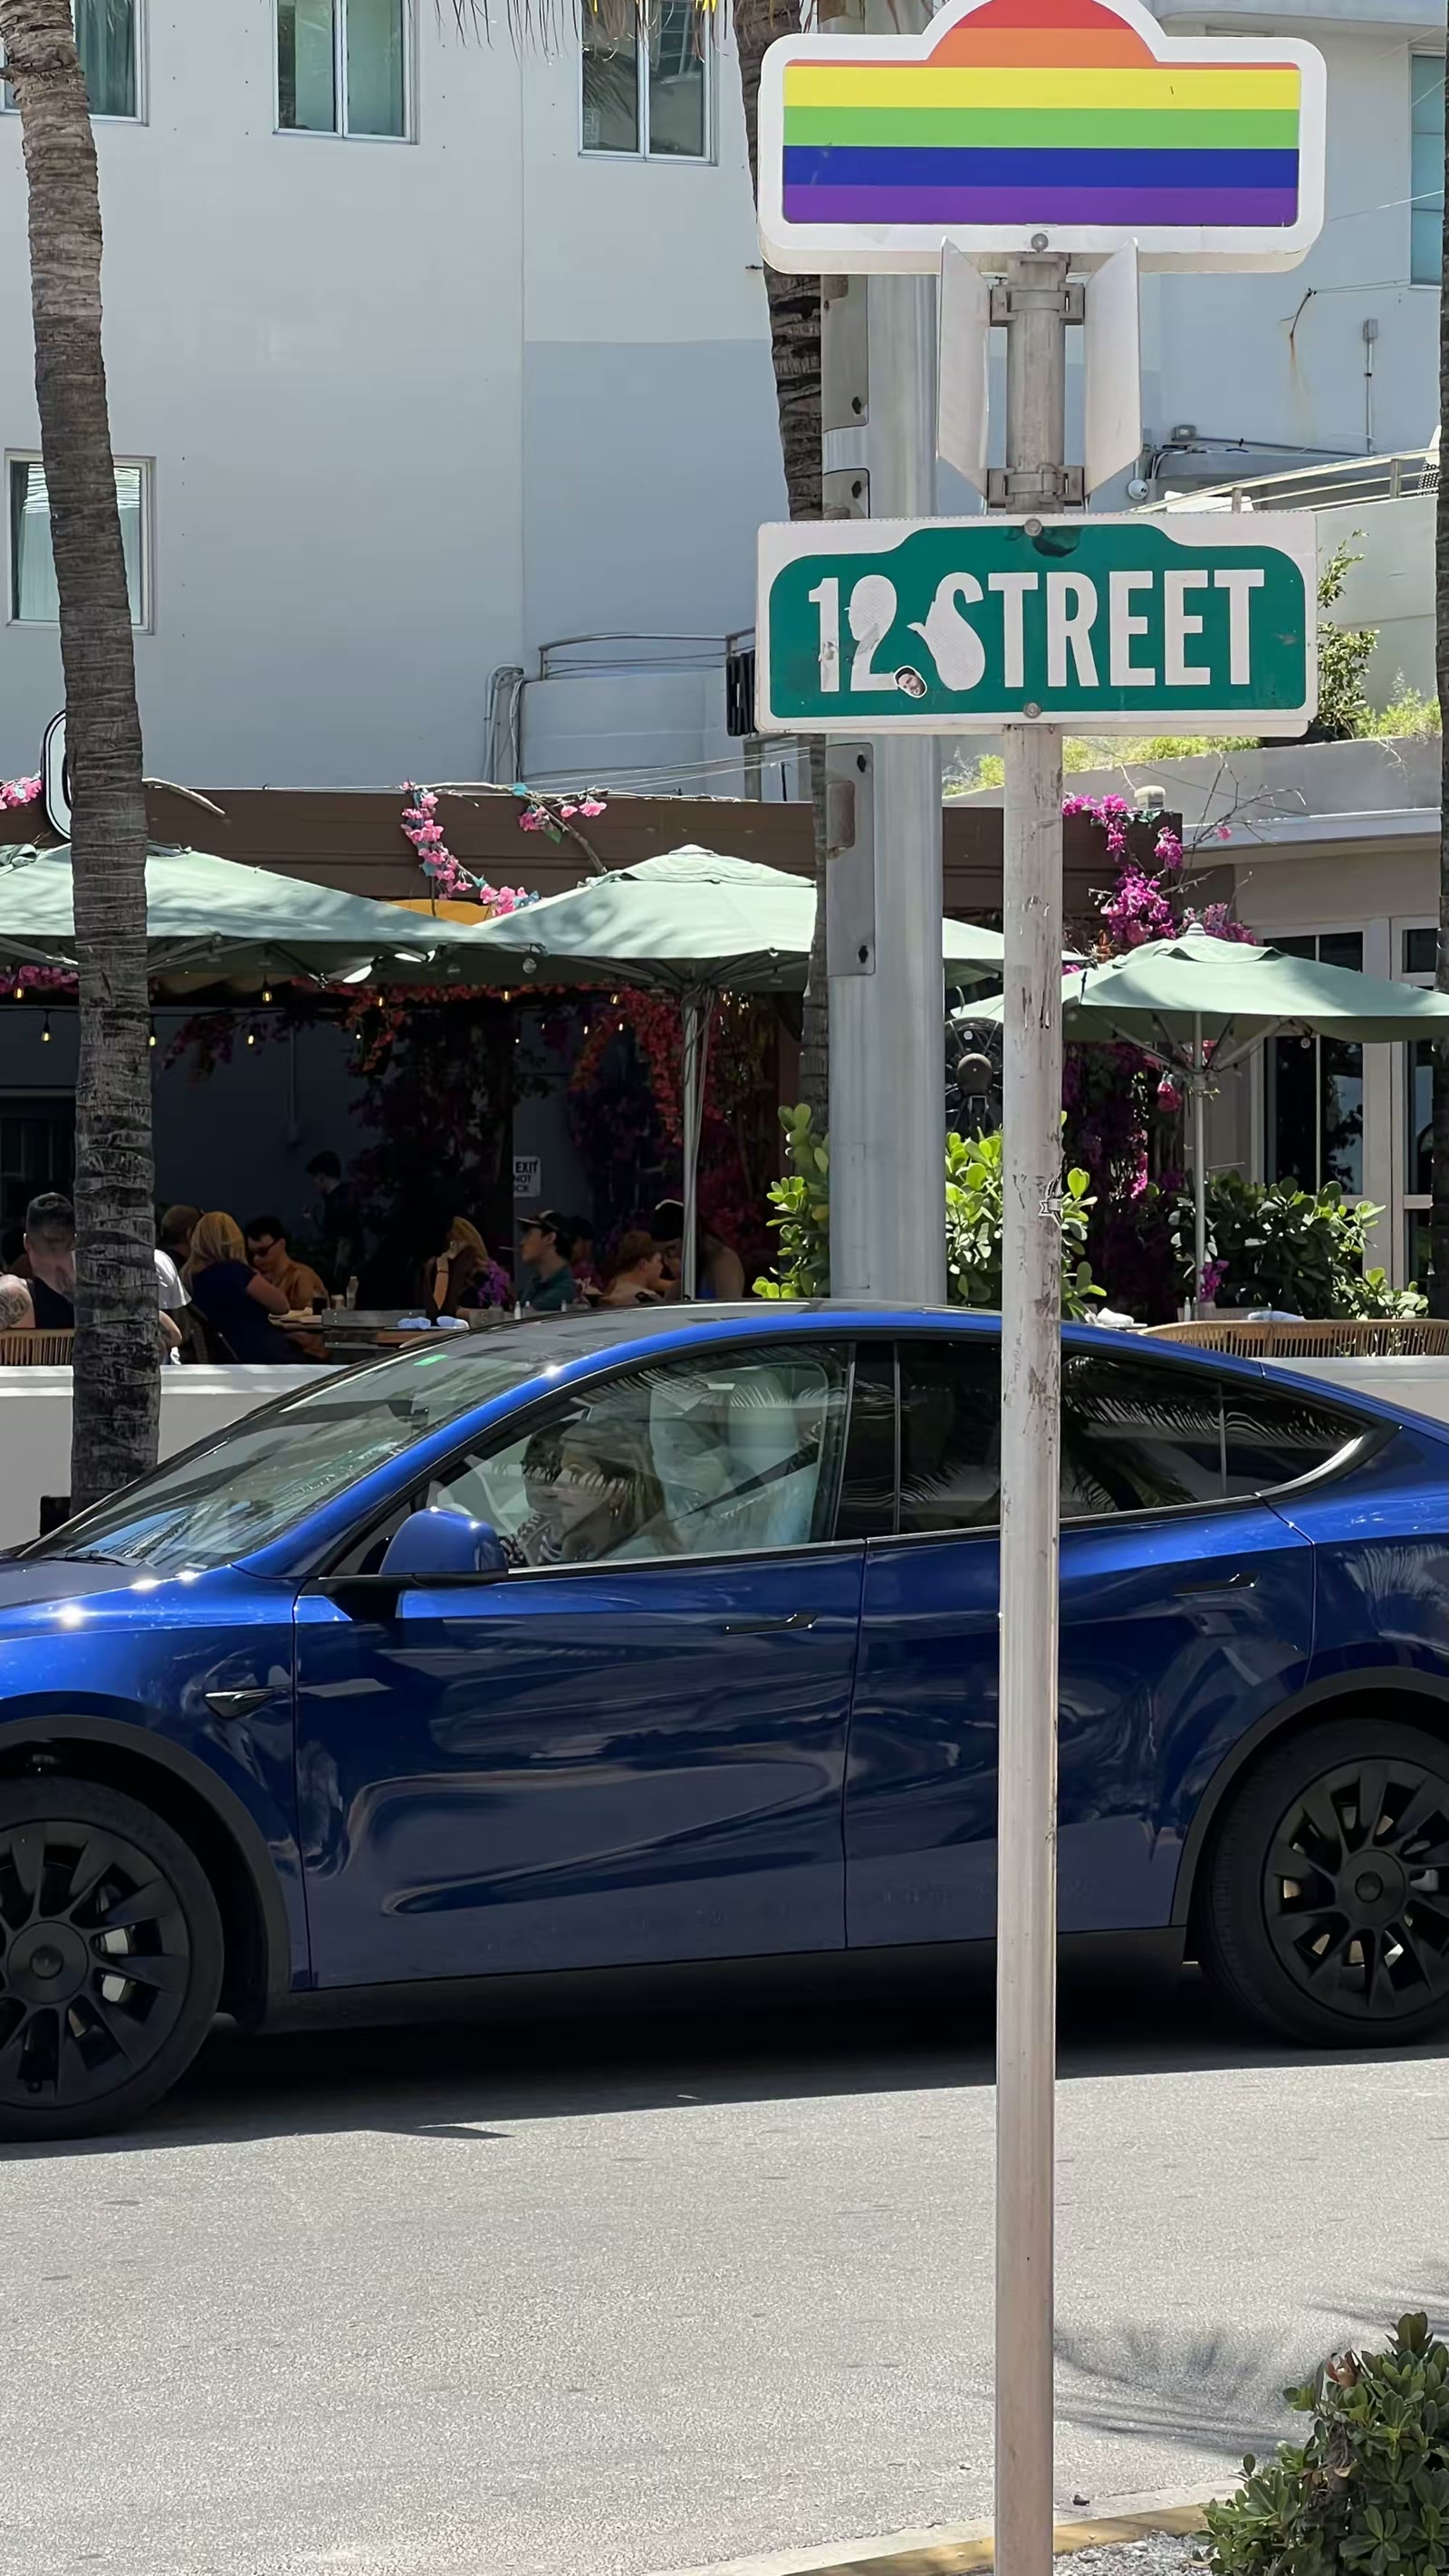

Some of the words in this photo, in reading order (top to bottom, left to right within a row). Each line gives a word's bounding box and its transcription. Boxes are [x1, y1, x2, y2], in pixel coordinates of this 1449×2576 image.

[809, 574, 898, 693] 12
[931, 569, 1265, 691] STREET
[515, 1161, 538, 1173] EXIT
